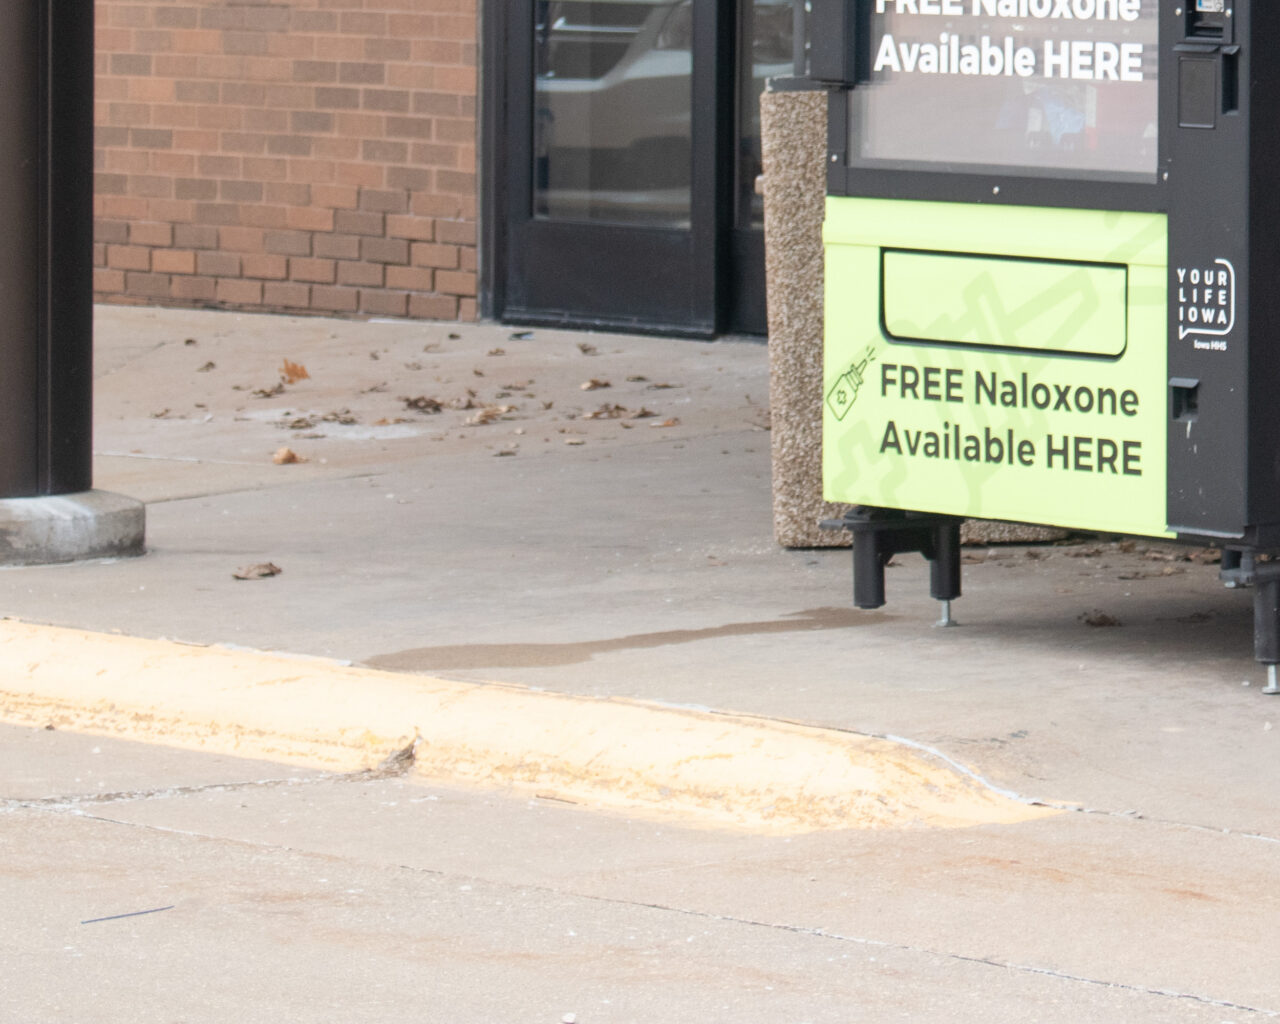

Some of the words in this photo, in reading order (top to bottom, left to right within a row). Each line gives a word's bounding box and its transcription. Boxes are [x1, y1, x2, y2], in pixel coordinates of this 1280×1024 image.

[874, 33, 1036, 78] Available
[1044, 40, 1143, 82] HERE
[1177, 268, 1228, 286] YOUR
[1179, 287, 1227, 305] LIFE
[1179, 306, 1228, 324] IOWA
[1194, 339, 1210, 350] Iowa
[880, 363, 965, 404] FREE
[974, 370, 1140, 417] Naloxone
[879, 420, 1036, 467] Available
[1045, 434, 1143, 477] HERE
